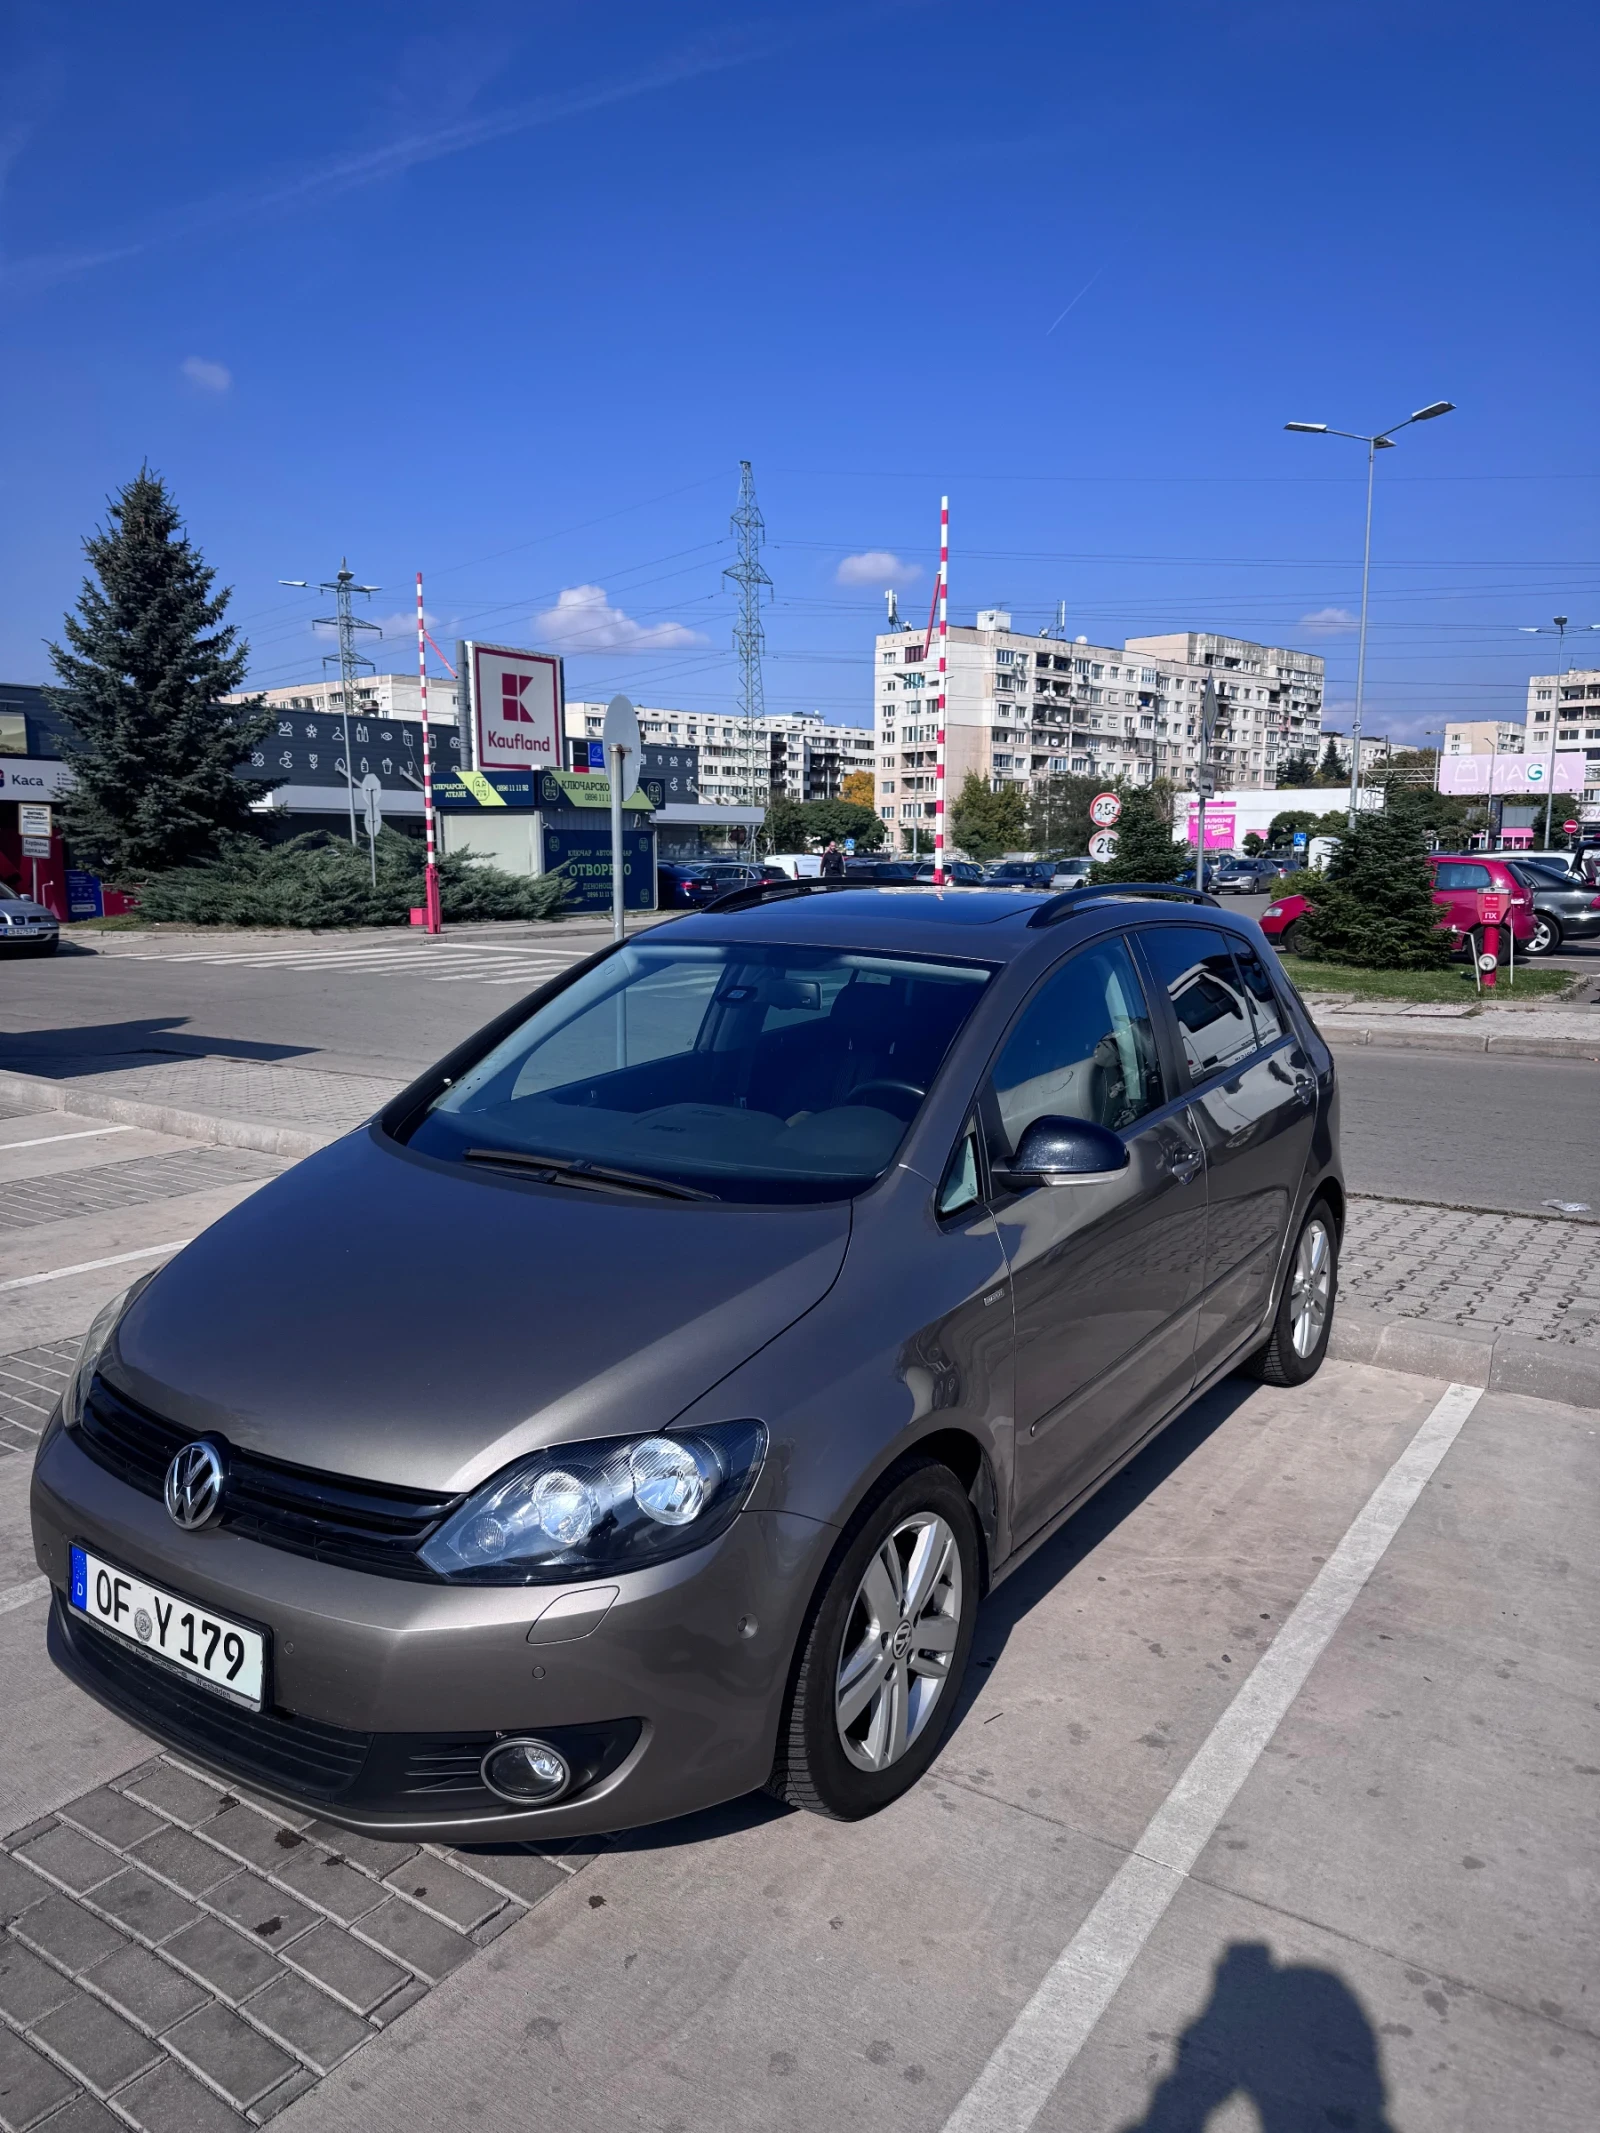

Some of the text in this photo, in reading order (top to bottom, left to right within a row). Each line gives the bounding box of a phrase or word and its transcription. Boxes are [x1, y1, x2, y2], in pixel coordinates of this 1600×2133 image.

[488, 730, 550, 752] Kaufland
[12, 774, 44, 786] Каса
[561, 780, 610, 792] КЛЮЧАРСКО
[585, 793, 598, 801] 0896
[567, 849, 633, 857] КЛЮЧАР АВТОКЧАР
[569, 864, 632, 876] ОТВОРЕО
[77, 1582, 83, 1596] D
[96, 1569, 132, 1622] OF
